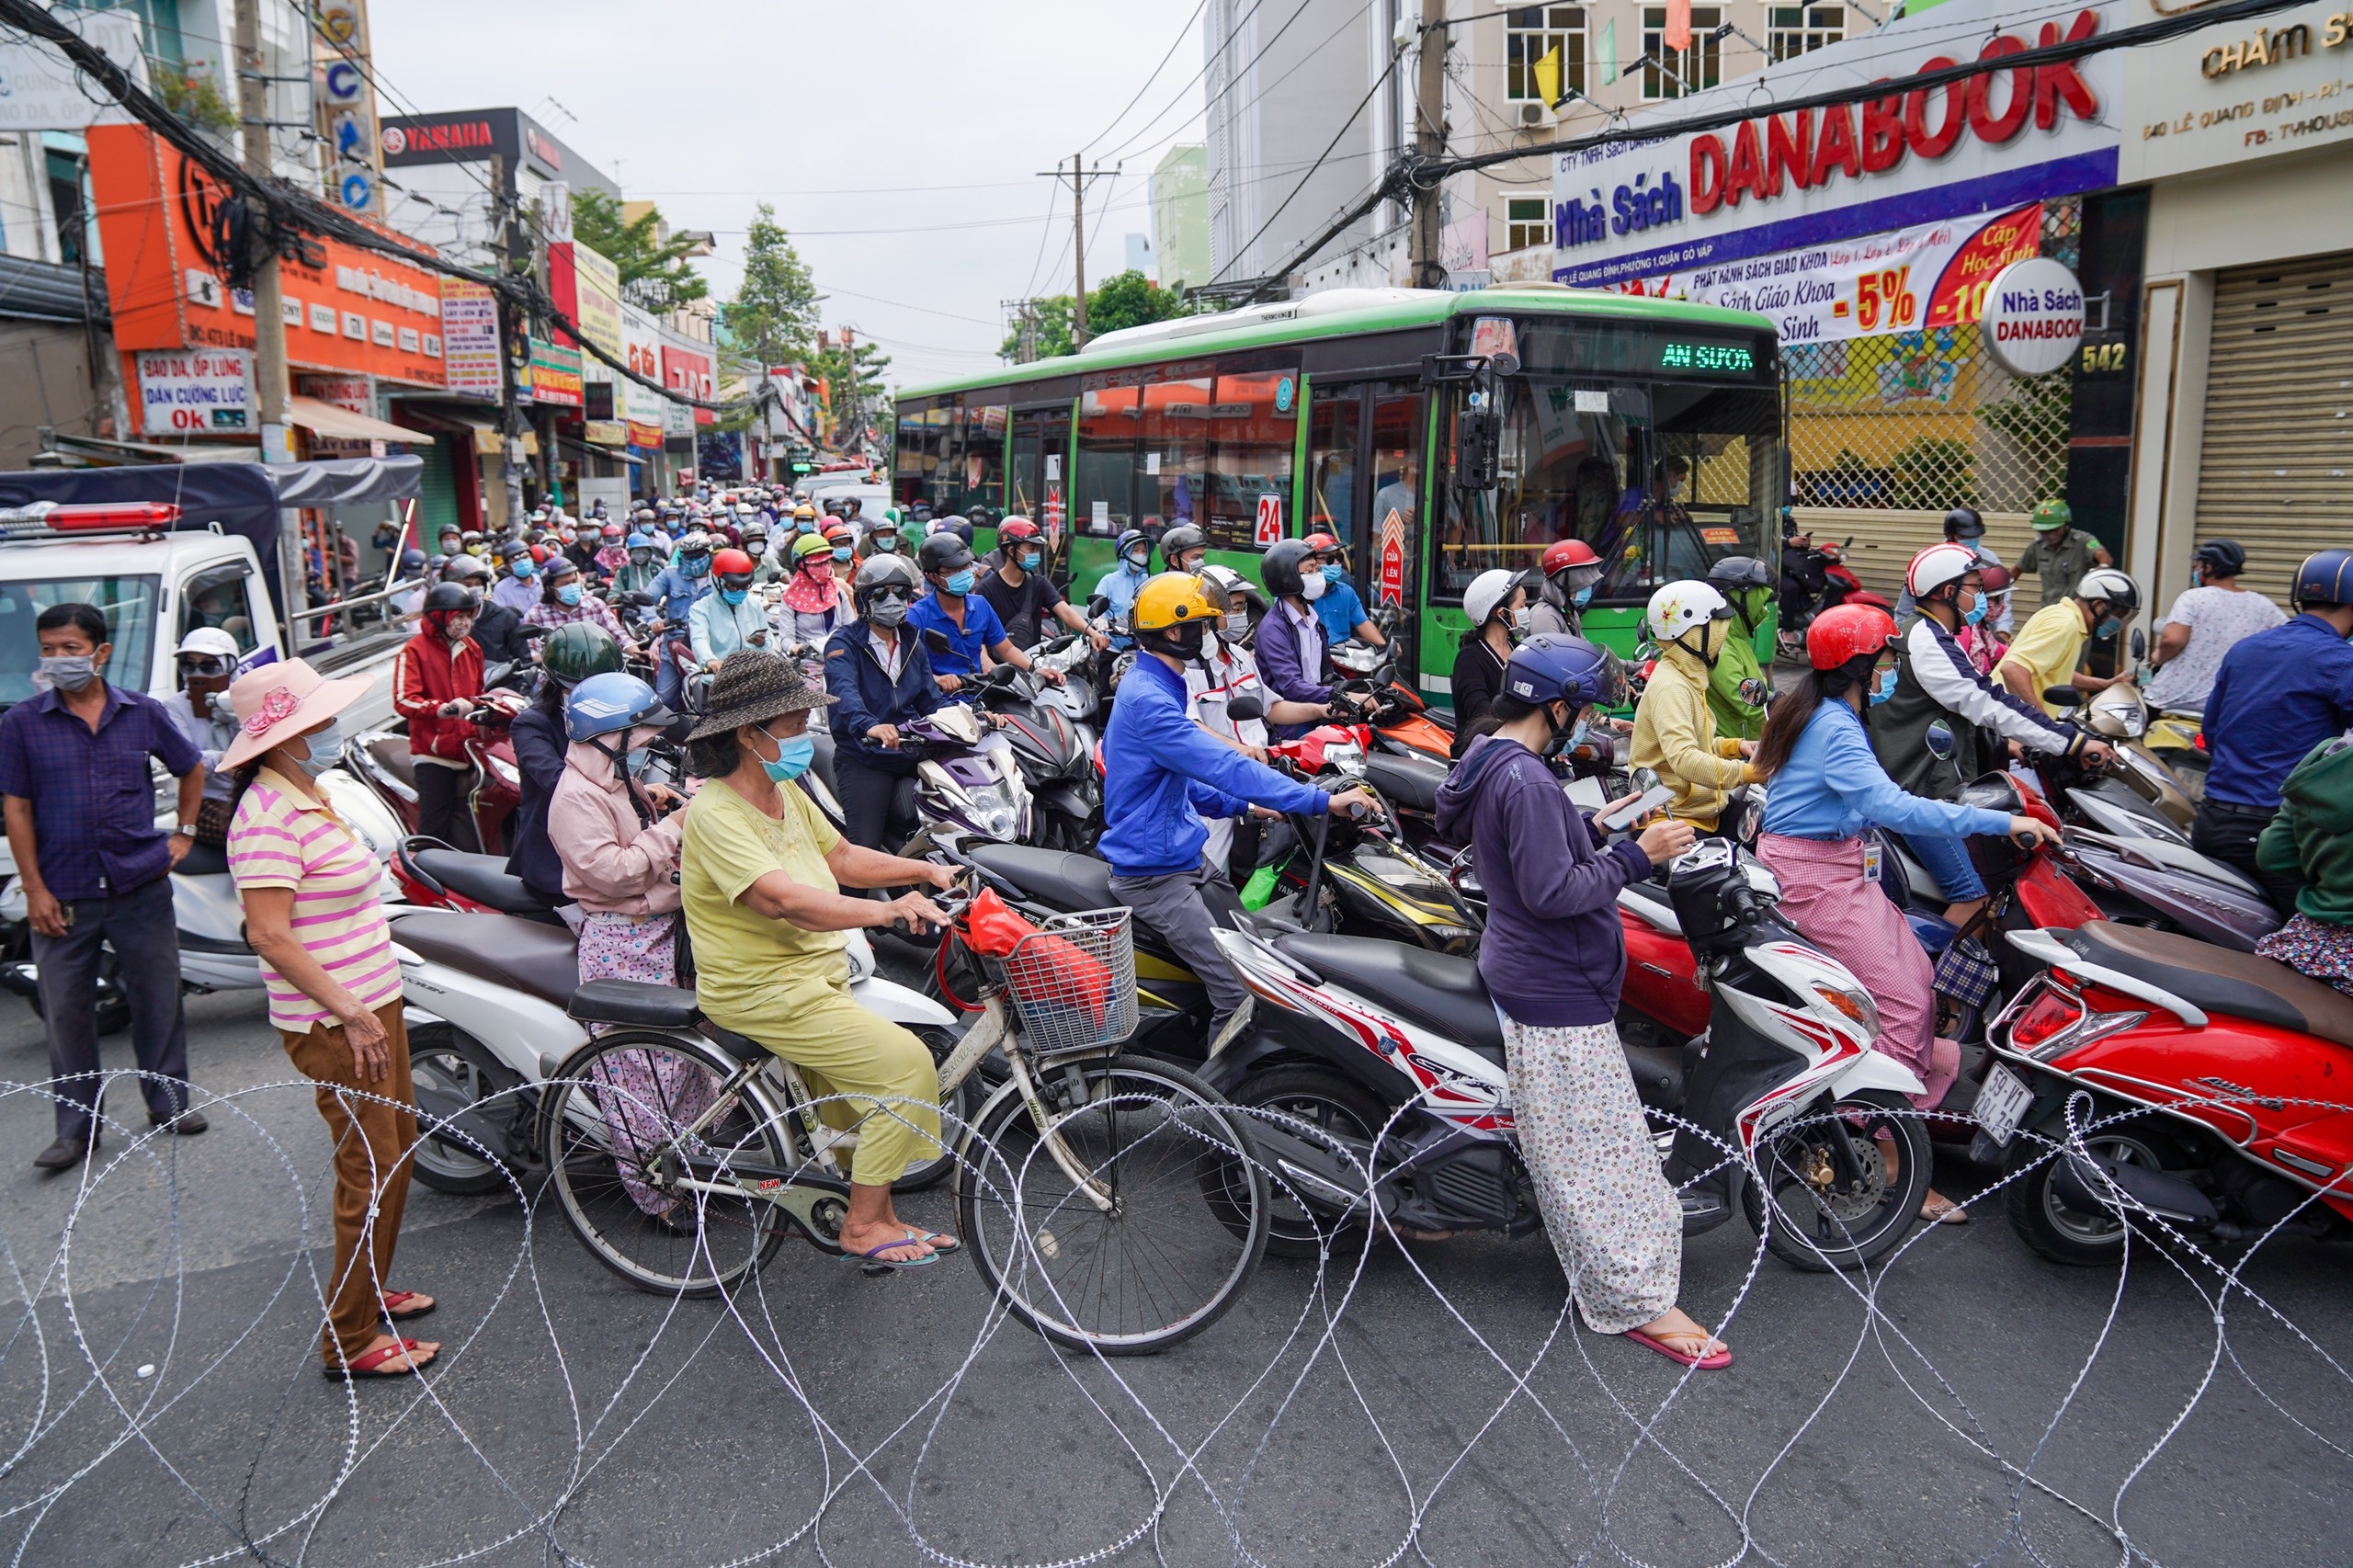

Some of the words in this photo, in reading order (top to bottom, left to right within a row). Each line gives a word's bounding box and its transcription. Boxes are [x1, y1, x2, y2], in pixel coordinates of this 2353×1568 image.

[1689, 9, 2101, 214] DANABOOK
[2200, 101, 2255, 129] QUANG
[404, 120, 493, 151] YAMAHA
[1561, 154, 1577, 173] CTY
[1581, 146, 1604, 166] TNHH
[1555, 188, 1606, 250] Nhà
[1611, 171, 1682, 236] Sách
[1983, 224, 2018, 248] Cặp
[1693, 268, 1716, 290] PHÁT
[1719, 265, 1744, 285] HÀNH
[1745, 258, 1771, 281] SÁCH
[1774, 255, 1798, 276] GIÁO
[1800, 251, 1827, 272] KHOA
[1961, 253, 1995, 276] Học
[1995, 243, 2036, 268] Sinh
[1578, 269, 1602, 283] QUANG
[1756, 284, 1790, 311] Giáo
[1794, 280, 1836, 306] Khoa
[2002, 289, 2039, 313] Nhà
[2044, 288, 2082, 311] Sách
[1780, 315, 1820, 341] Sinh
[1997, 318, 2083, 341] DANABOOK
[144, 358, 167, 378] BAO
[1663, 344, 1690, 367] AN
[2082, 342, 2126, 373] 542
[146, 385, 173, 404] DÁN
[172, 409, 206, 429] Ok
[1258, 499, 1280, 543] 24
[1386, 566, 1398, 577] LÊN
[1299, 993, 1339, 1014] AUTOMATIC
[759, 1178, 779, 1191] NEW
